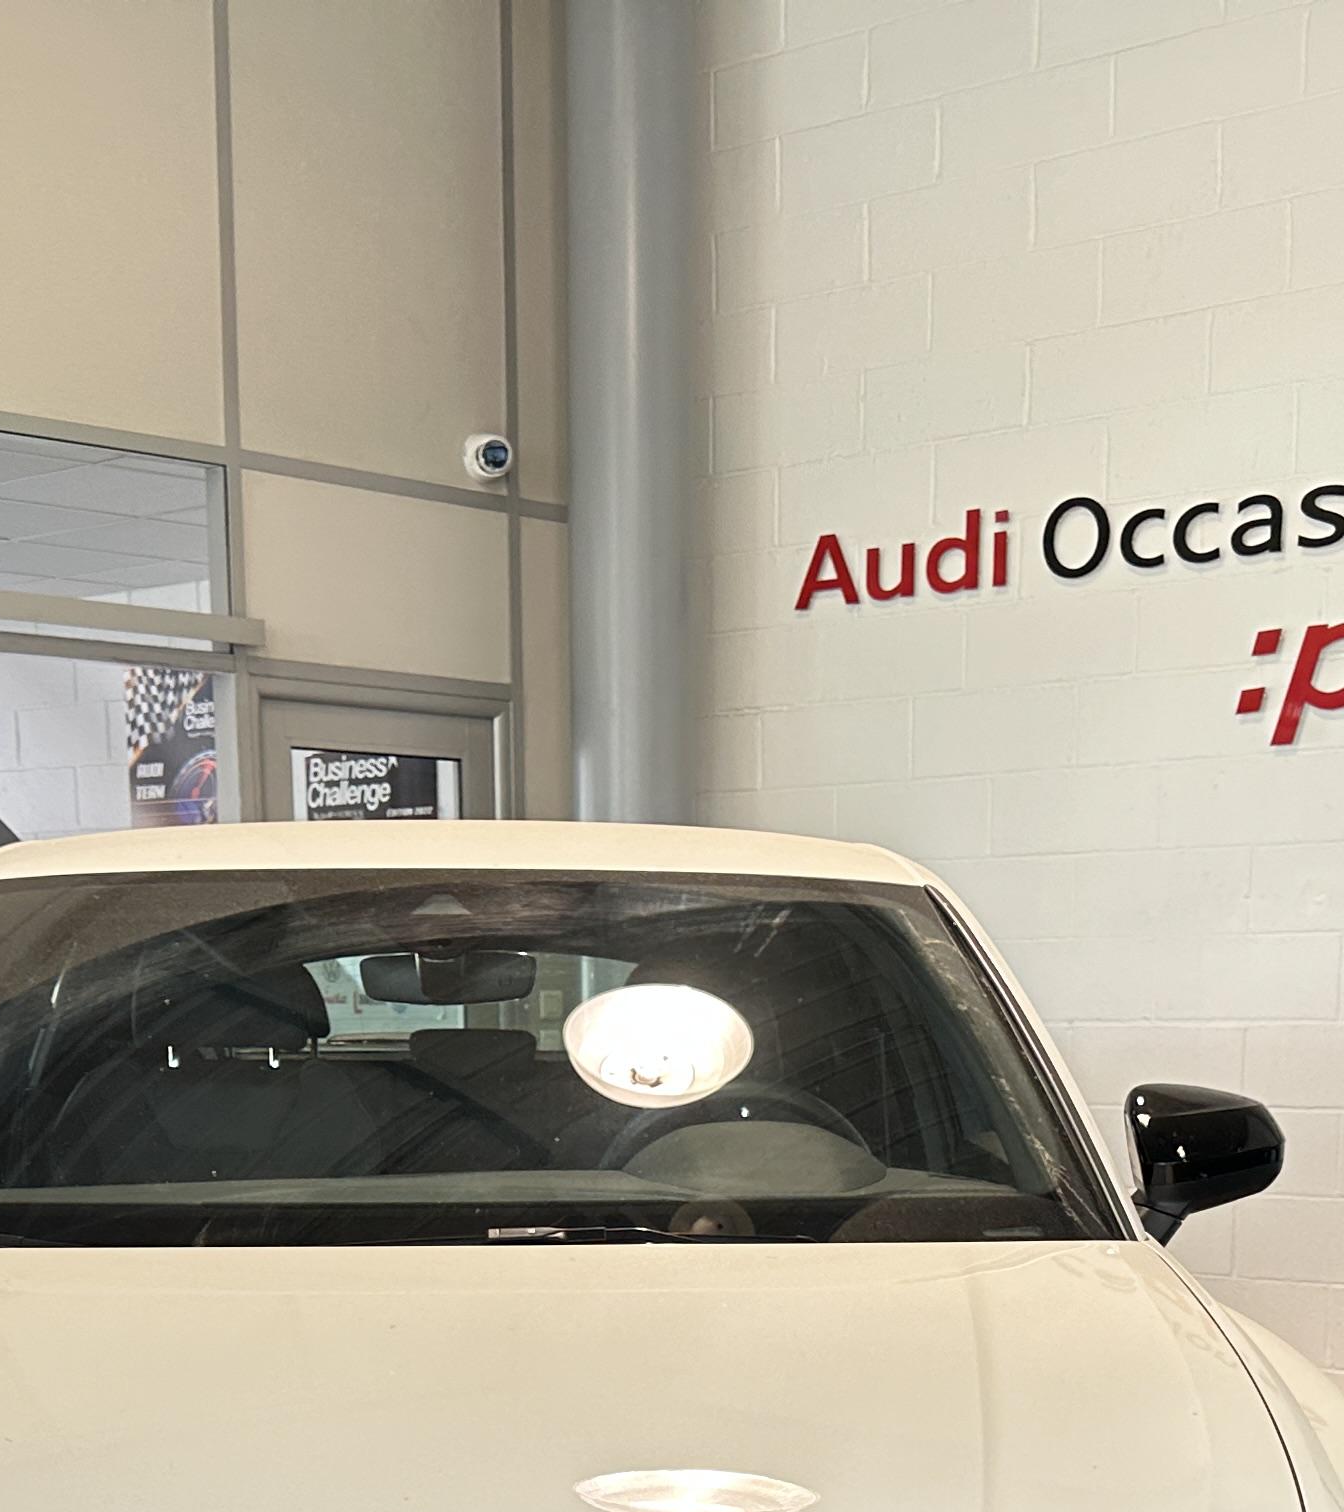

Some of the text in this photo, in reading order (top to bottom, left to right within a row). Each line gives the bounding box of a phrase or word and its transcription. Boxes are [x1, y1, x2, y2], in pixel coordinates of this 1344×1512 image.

[796, 508, 1009, 609] Audi
[309, 755, 388, 783] Business
[308, 780, 392, 811] Challenge
